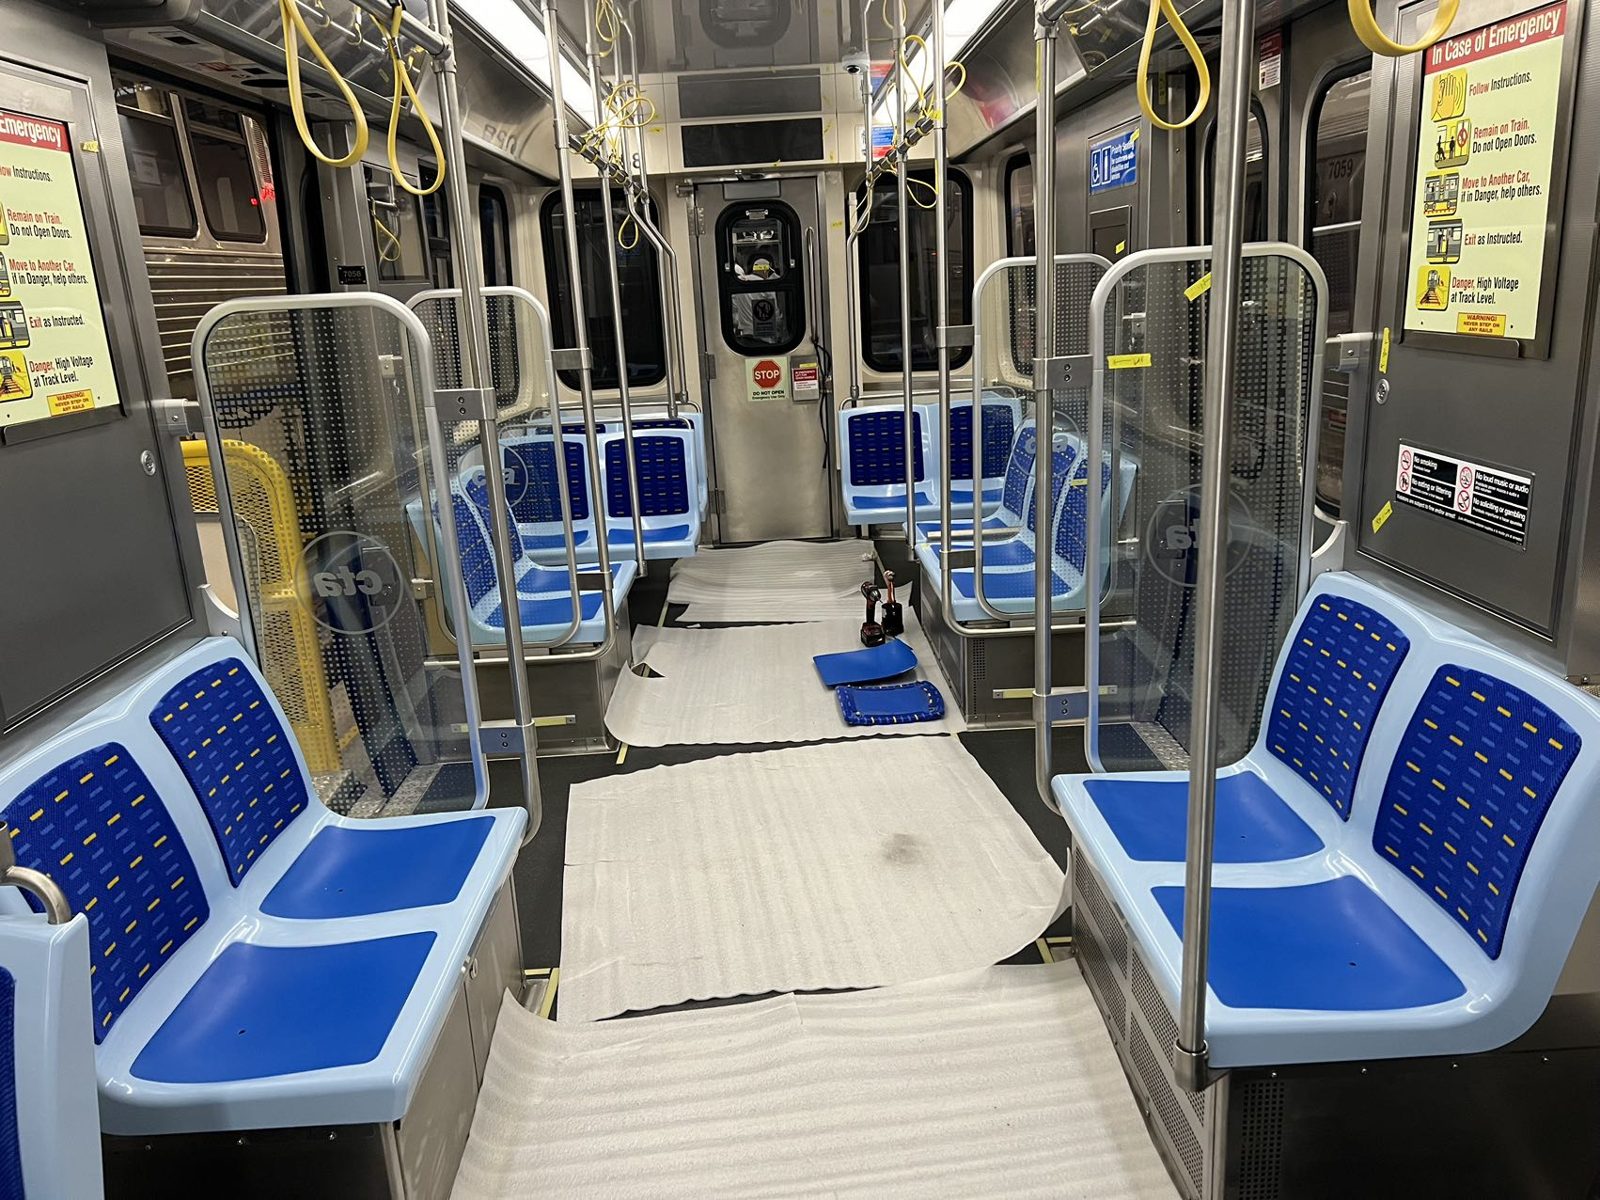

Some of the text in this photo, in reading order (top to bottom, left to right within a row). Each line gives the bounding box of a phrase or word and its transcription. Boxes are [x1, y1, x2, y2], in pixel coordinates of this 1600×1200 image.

[1432, 8, 1561, 66] In Case of Emergency
[1469, 72, 1532, 96] Follow Instructions.
[1474, 118, 1530, 139] Remain on Train.
[1473, 134, 1537, 153] Do not Open Doors.
[12, 165, 53, 182] Instructions.
[1329, 159, 1353, 179] 7059
[1462, 170, 1531, 189] Move to Another Car,
[1461, 184, 1542, 203] if in Danger, help others.
[7, 209, 62, 224] Remain on Train.
[10, 224, 72, 239] Do not Open Doors.
[1464, 231, 1523, 245] Exit as Instructed.
[9, 259, 28, 271] Move
[29, 260, 36, 271] to
[38, 259, 62, 272] Another
[11, 272, 89, 287] if in Danger, help others.
[1452, 277, 1519, 291] Danger, High Voltage
[1450, 291, 1496, 305] at Track Level.
[29, 314, 85, 328] Exit as Instructed.
[29, 356, 93, 373] Danger, High Voltage
[34, 371, 79, 387] at Track Level.
[754, 370, 780, 380] STOP
[1420, 459, 1438, 470] smoking
[1476, 472, 1483, 480] No
[1483, 474, 1494, 483] loud
[1494, 478, 1508, 487] music
[1515, 484, 1529, 494] audio
[1473, 497, 1480, 505] No
[1480, 500, 1499, 513] soliciting
[1504, 509, 1526, 522] gambling
